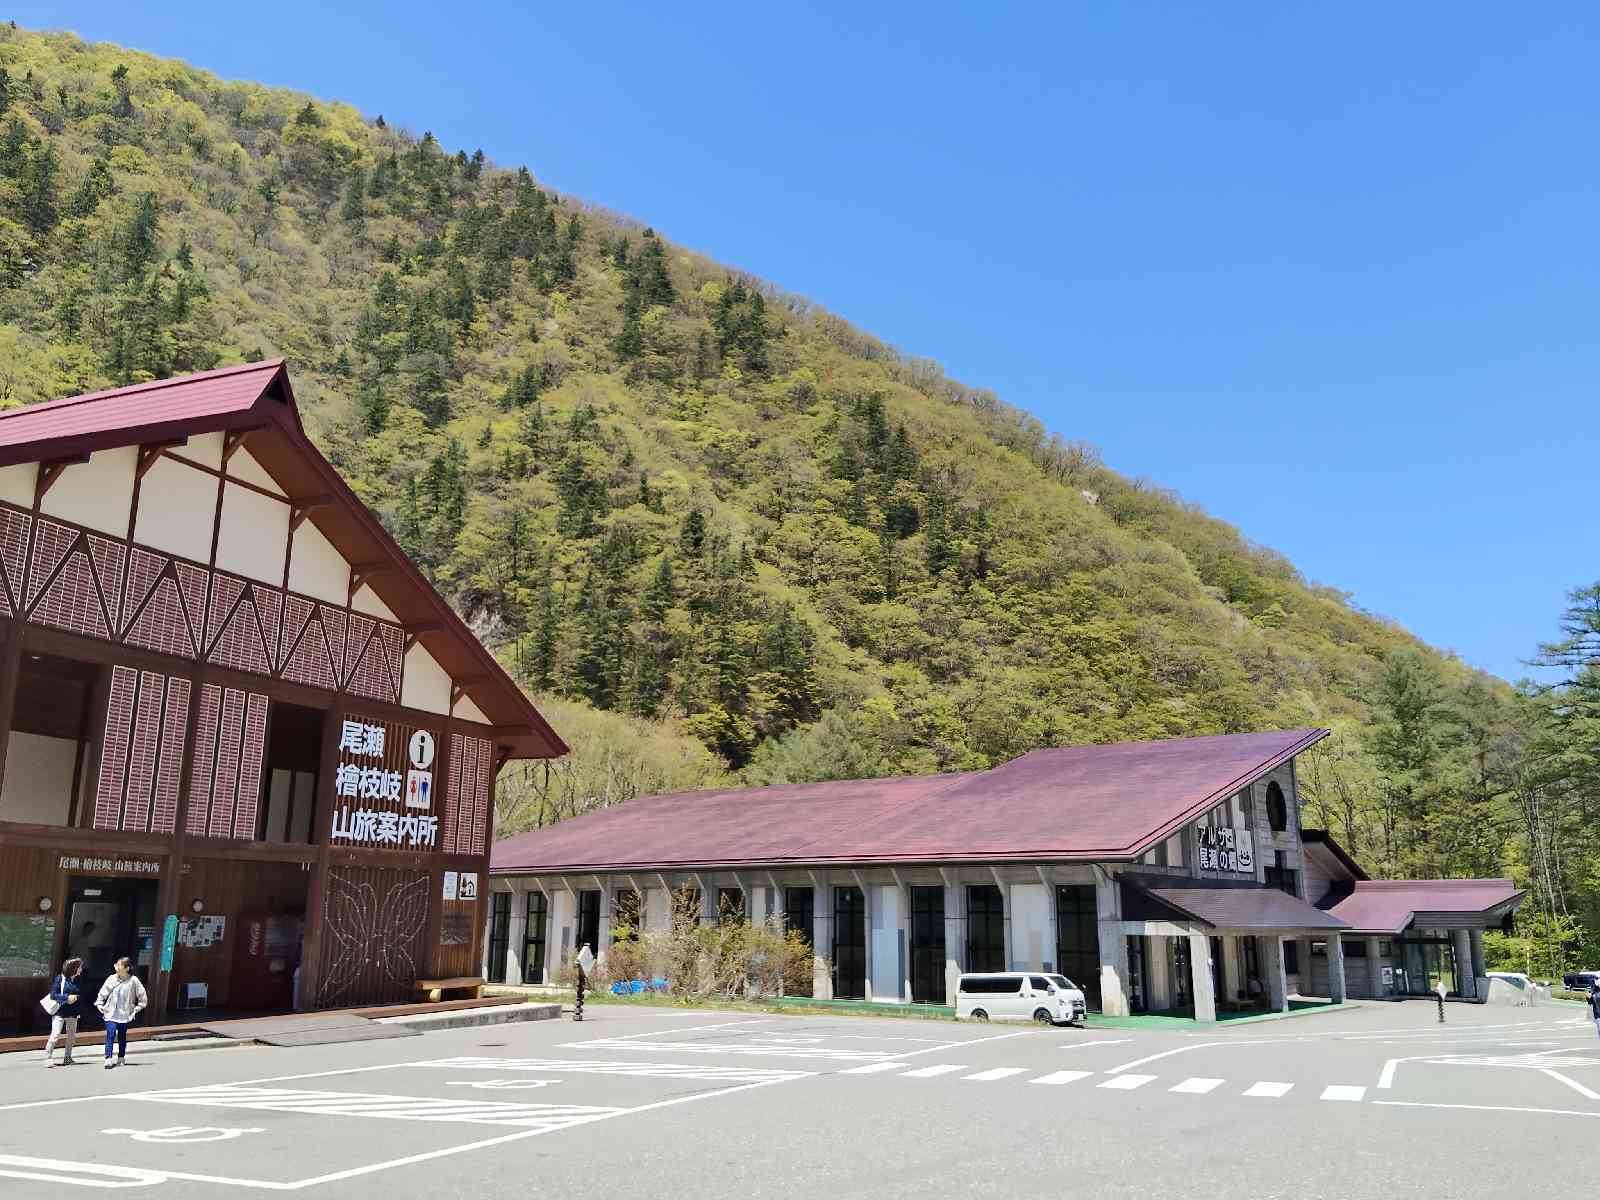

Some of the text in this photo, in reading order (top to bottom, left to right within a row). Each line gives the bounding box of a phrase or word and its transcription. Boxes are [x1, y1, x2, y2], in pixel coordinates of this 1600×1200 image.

[338, 720, 386, 758] 尾瀬
[335, 762, 402, 802] 檜枝岐
[331, 805, 438, 846] 山旅案内所
